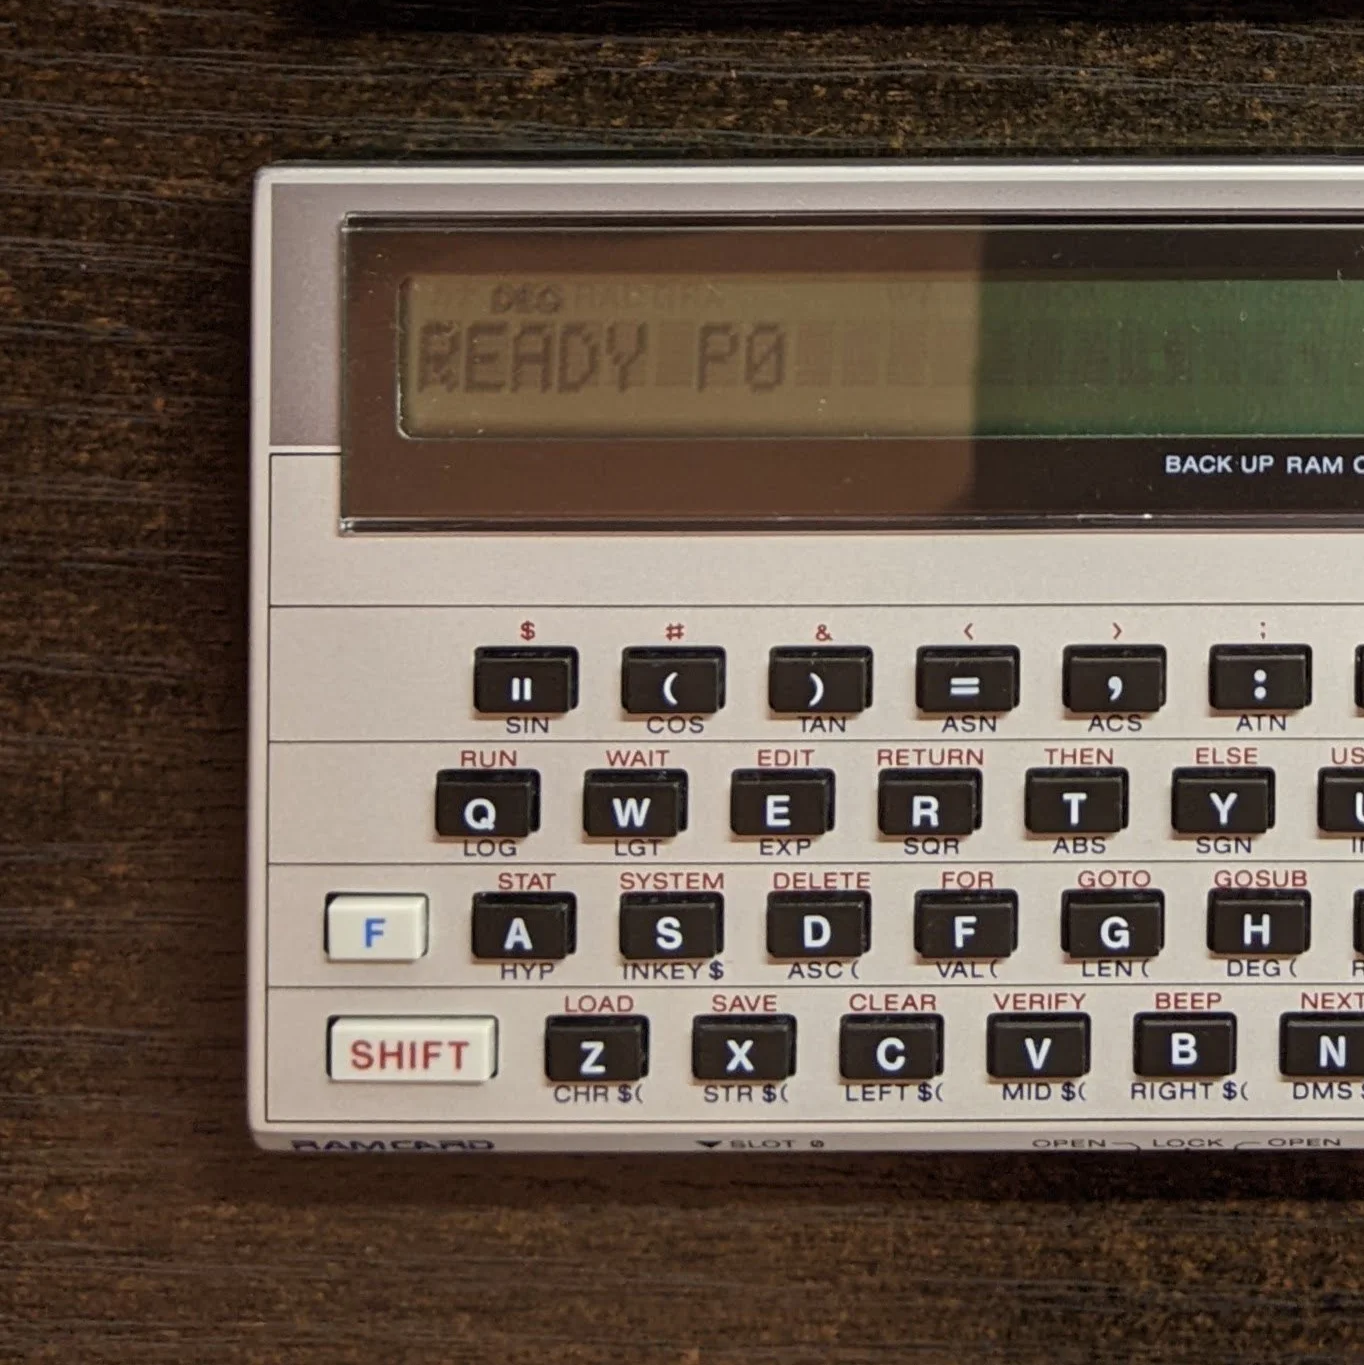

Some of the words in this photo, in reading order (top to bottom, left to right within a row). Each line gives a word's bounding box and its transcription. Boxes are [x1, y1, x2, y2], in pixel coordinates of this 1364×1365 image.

[417, 321, 648, 394] READY
[1165, 455, 1233, 474] BACK
[1241, 455, 1274, 474] UP
[1286, 455, 1343, 474] RAM
[506, 717, 549, 734] SIN
[646, 716, 704, 733] COS
[797, 715, 846, 733] TAN
[941, 715, 997, 733] ASN
[1088, 715, 1142, 733] ACS
[1236, 715, 1287, 733] ATN
[460, 750, 517, 767] RUN
[606, 750, 670, 766] WAIT
[757, 749, 815, 766] EDIT
[877, 749, 984, 766] RETURN
[1044, 748, 1114, 765] THEN
[1196, 747, 1258, 764] ELSE
[463, 798, 496, 831] Q
[611, 798, 650, 828] W
[765, 795, 791, 827] E
[911, 795, 939, 827] R
[1063, 793, 1087, 825] T
[1210, 792, 1237, 825] Y
[463, 840, 517, 856] LOG
[614, 839, 661, 856] LGT
[759, 838, 811, 856] EXP
[903, 837, 960, 855] SQR
[1053, 837, 1106, 854] ABS
[1196, 837, 1252, 854] SGN
[497, 873, 556, 890] STAT
[619, 872, 725, 890] SYSTEM
[773, 872, 871, 890] DELETE
[942, 871, 994, 889] FOR
[1077, 870, 1152, 888] GOTO
[1214, 870, 1308, 888] GOSUB
[364, 918, 386, 948] F
[503, 917, 532, 950] A
[655, 916, 683, 950] S
[803, 916, 831, 947] D
[954, 916, 977, 947] F
[1100, 917, 1130, 948] G
[1243, 913, 1271, 946] H
[501, 963, 555, 980] HYP
[565, 996, 634, 1013] LOAD
[712, 995, 777, 1012] SAVE
[849, 993, 936, 1012] CLEAR
[994, 992, 1086, 1010] VERIFY
[1155, 992, 1222, 1010] BEEP
[350, 1040, 470, 1070] SHIFT
[580, 1041, 605, 1073] Z
[726, 1040, 754, 1072] X
[876, 1037, 905, 1072] C
[1025, 1037, 1052, 1070] V
[1171, 1032, 1198, 1065] B
[1319, 1035, 1346, 1068] N
[1032, 1139, 1106, 1148] OPEN
[1152, 1138, 1224, 1147] LOCK
[1267, 1137, 1341, 1147] OPEN
